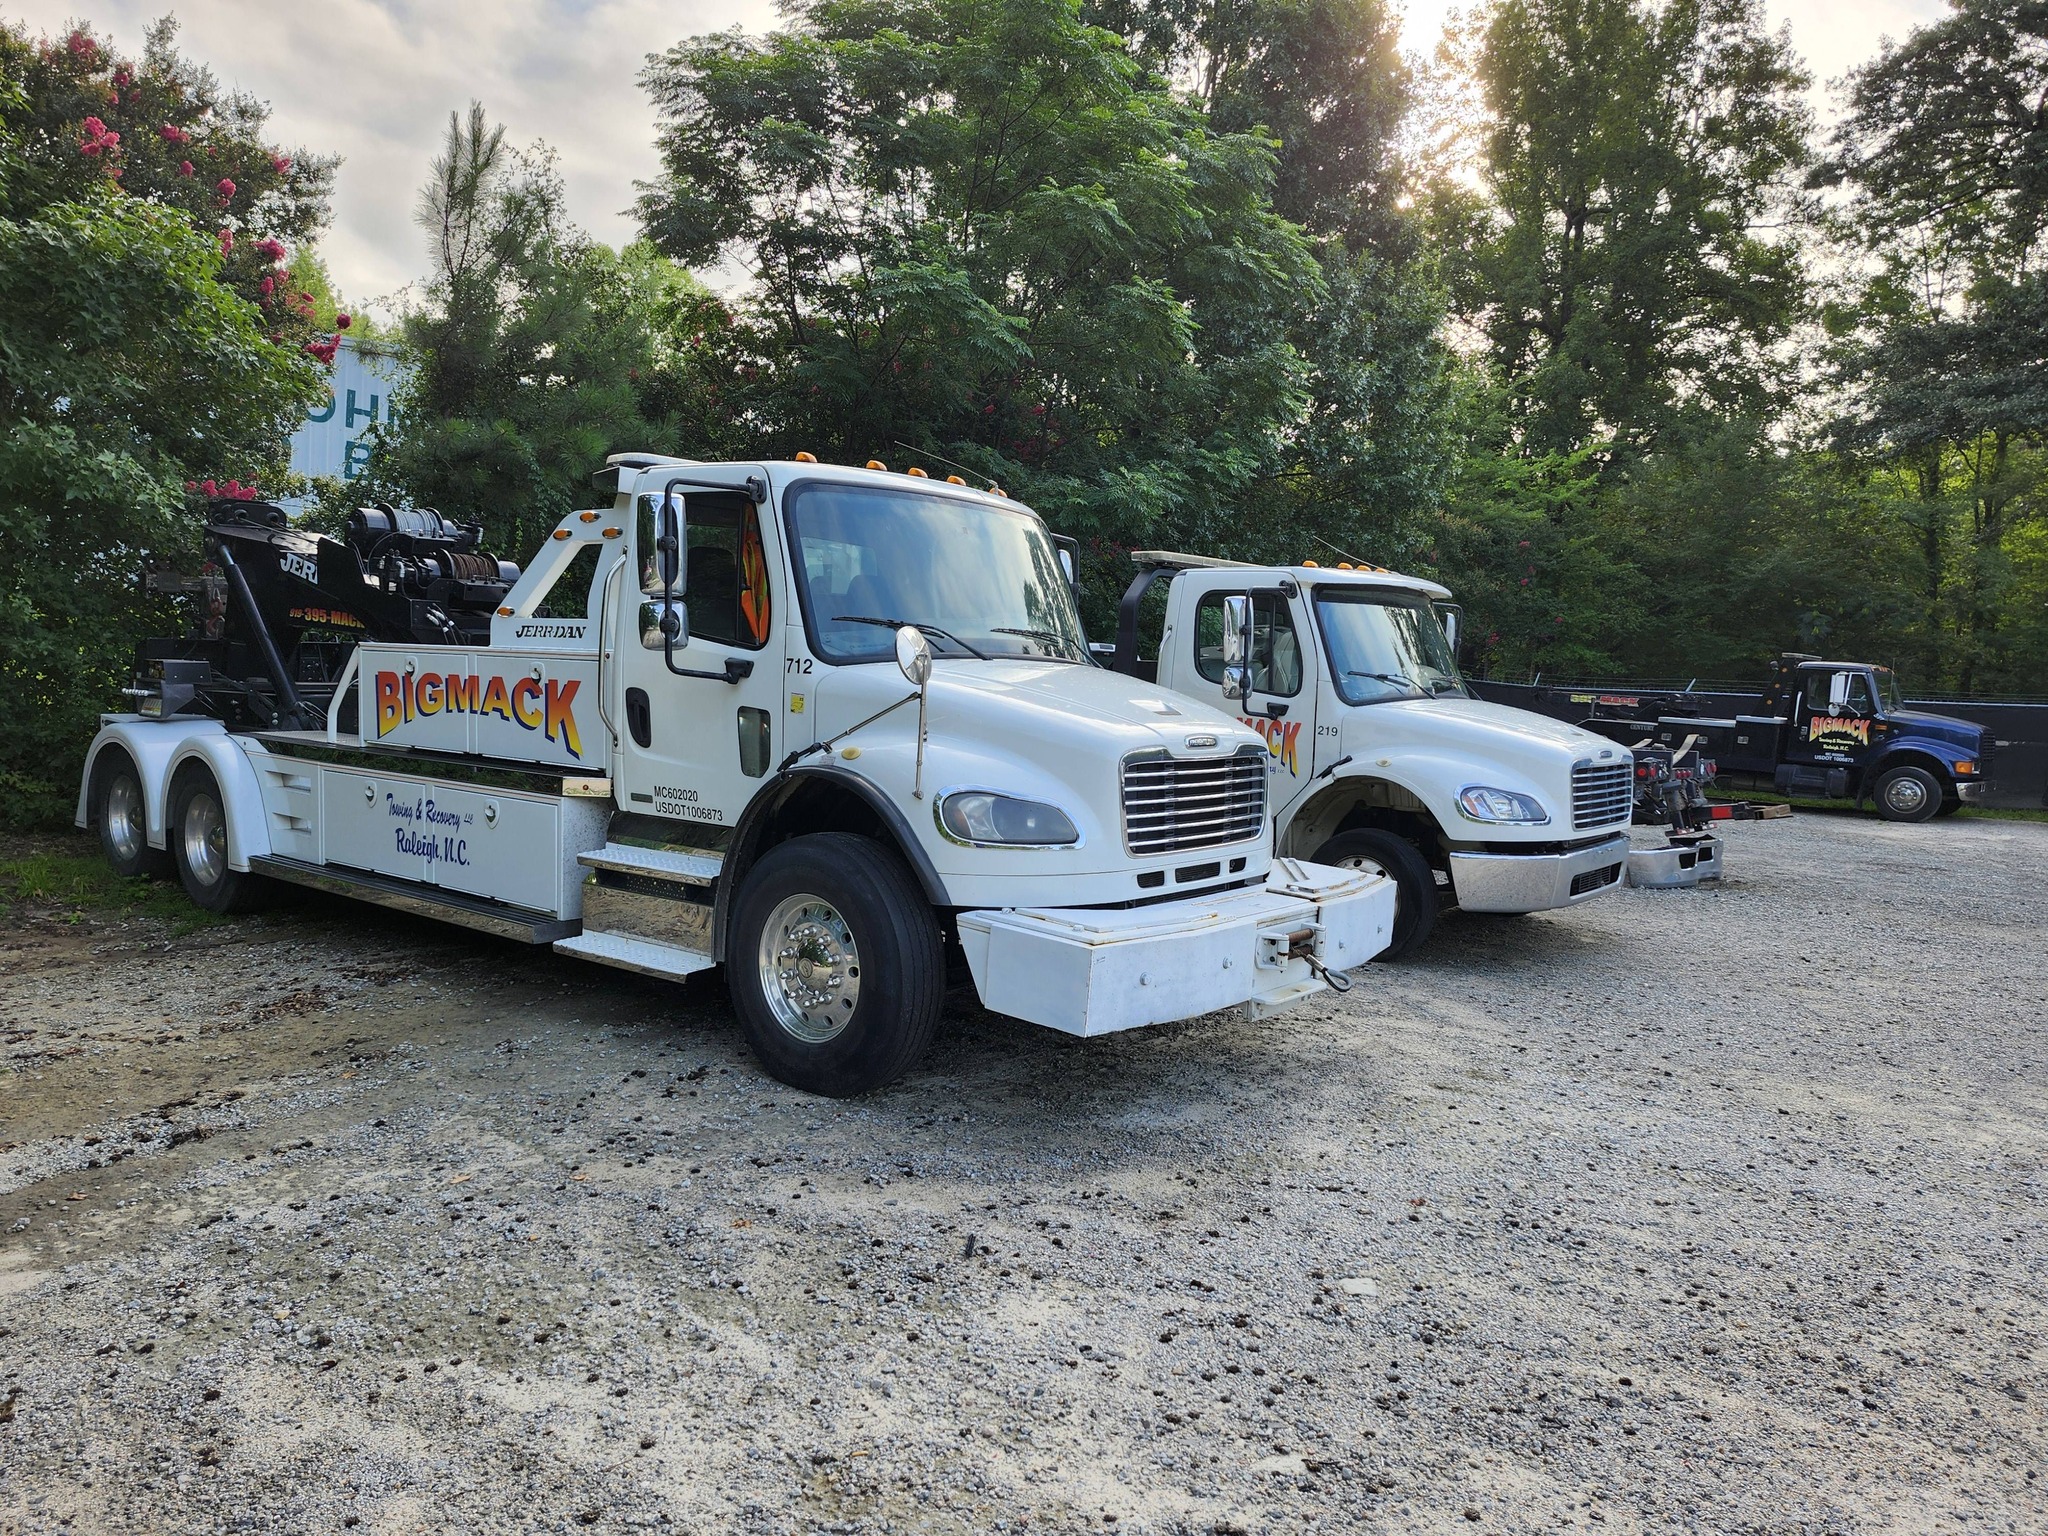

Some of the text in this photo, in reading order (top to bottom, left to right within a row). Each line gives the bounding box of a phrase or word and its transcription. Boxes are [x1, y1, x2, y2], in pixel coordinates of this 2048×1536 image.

[280, 552, 318, 585] JER
[786, 658, 813, 674] 712
[375, 671, 584, 760] BIGMACK
[1317, 726, 1338, 737] 219
[1809, 717, 1870, 746] BIGMACK
[654, 785, 698, 802] MC602020
[386, 793, 413, 826] Towing
[416, 798, 422, 820] &
[425, 800, 461, 833] Recovery
[655, 801, 723, 822] USDOT1006873
[395, 827, 470, 866] Raleigh, N.C.
